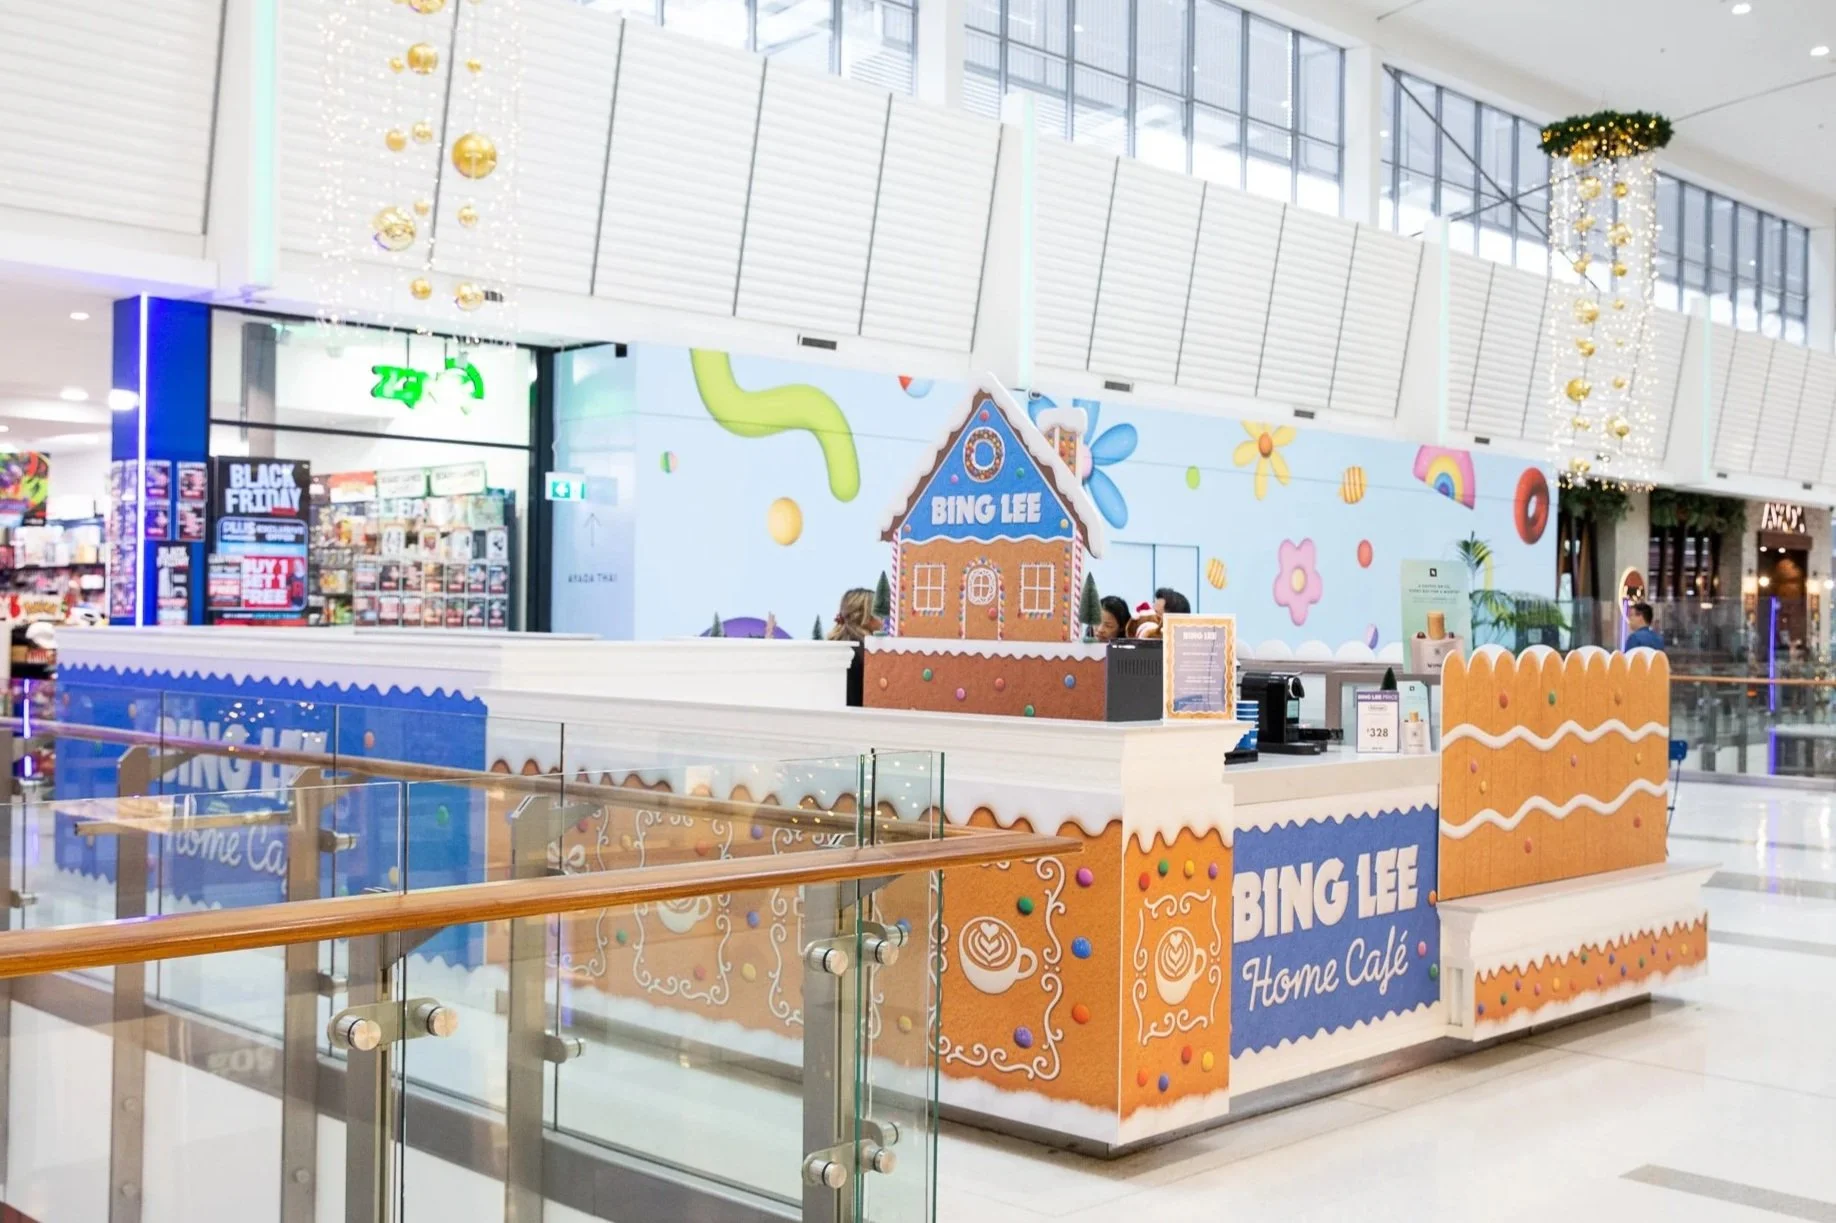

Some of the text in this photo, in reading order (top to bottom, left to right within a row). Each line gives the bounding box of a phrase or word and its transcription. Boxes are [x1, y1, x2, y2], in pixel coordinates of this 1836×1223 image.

[229, 463, 297, 489] BLACK
[225, 488, 302, 514] FRIDAY
[931, 492, 1042, 525] BING LEE
[1232, 844, 1419, 944] BING LEE
[1242, 925, 1409, 1012] Home Café
